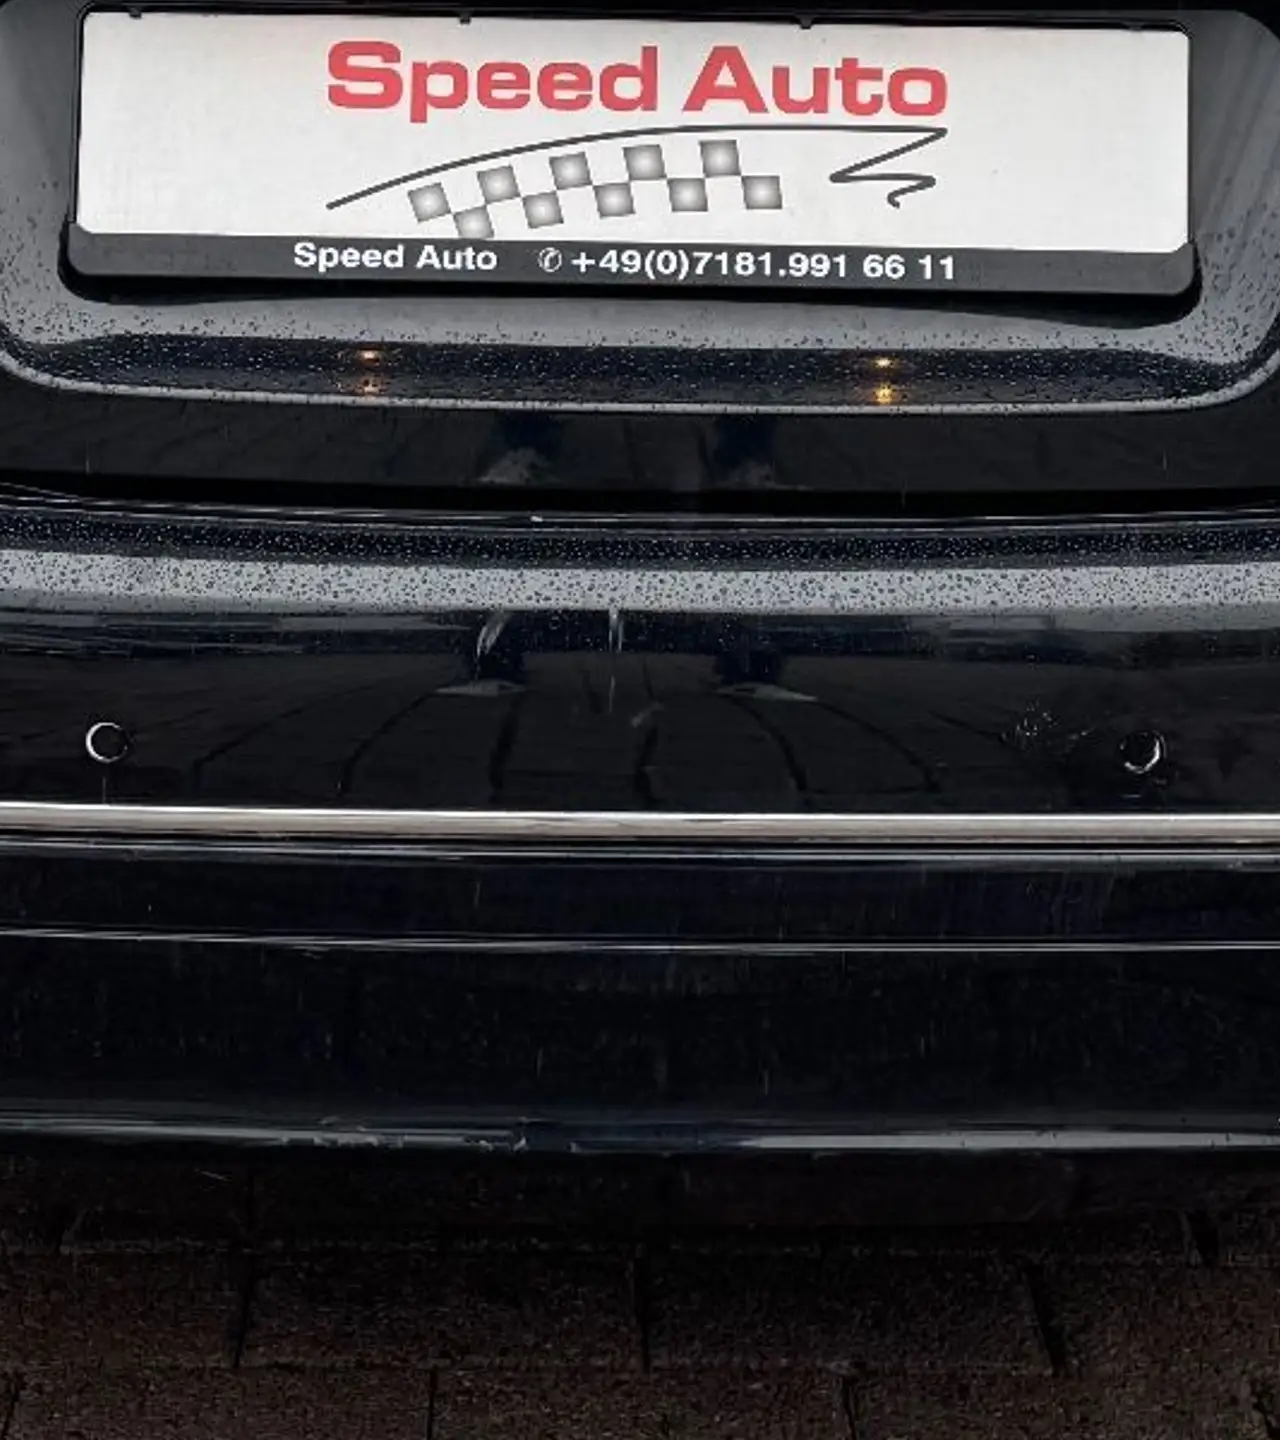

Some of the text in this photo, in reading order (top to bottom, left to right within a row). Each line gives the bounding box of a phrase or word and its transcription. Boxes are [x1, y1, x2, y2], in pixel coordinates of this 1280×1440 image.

[326, 40, 948, 124] Speed Auto
[293, 241, 956, 280] Speed Auto +49(0)7181.991 66 11
